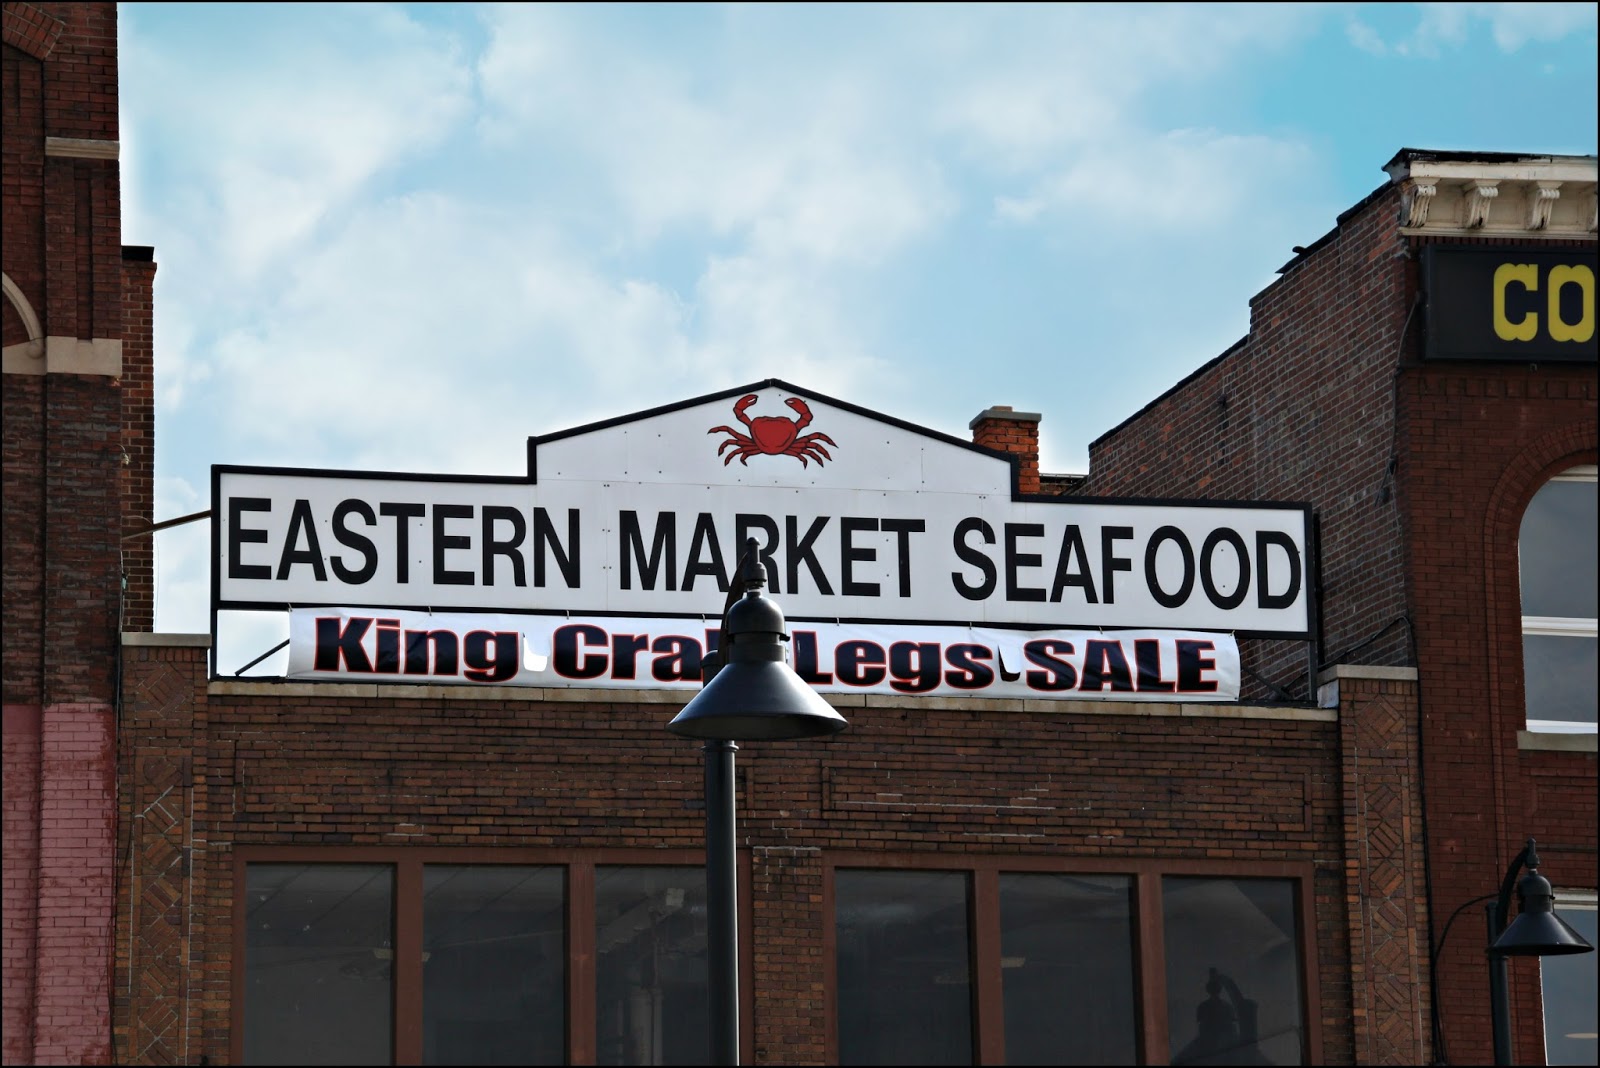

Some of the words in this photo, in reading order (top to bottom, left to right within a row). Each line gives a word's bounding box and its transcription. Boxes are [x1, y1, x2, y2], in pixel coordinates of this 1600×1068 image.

[1493, 262, 1596, 343] CO
[228, 496, 581, 589] EASTERN
[619, 510, 926, 598] MARKET
[950, 516, 1302, 611] SEAFOOD
[312, 616, 520, 683] King
[551, 623, 723, 684] Cra
[791, 630, 996, 694] Legs
[1023, 637, 1219, 693] SALE
